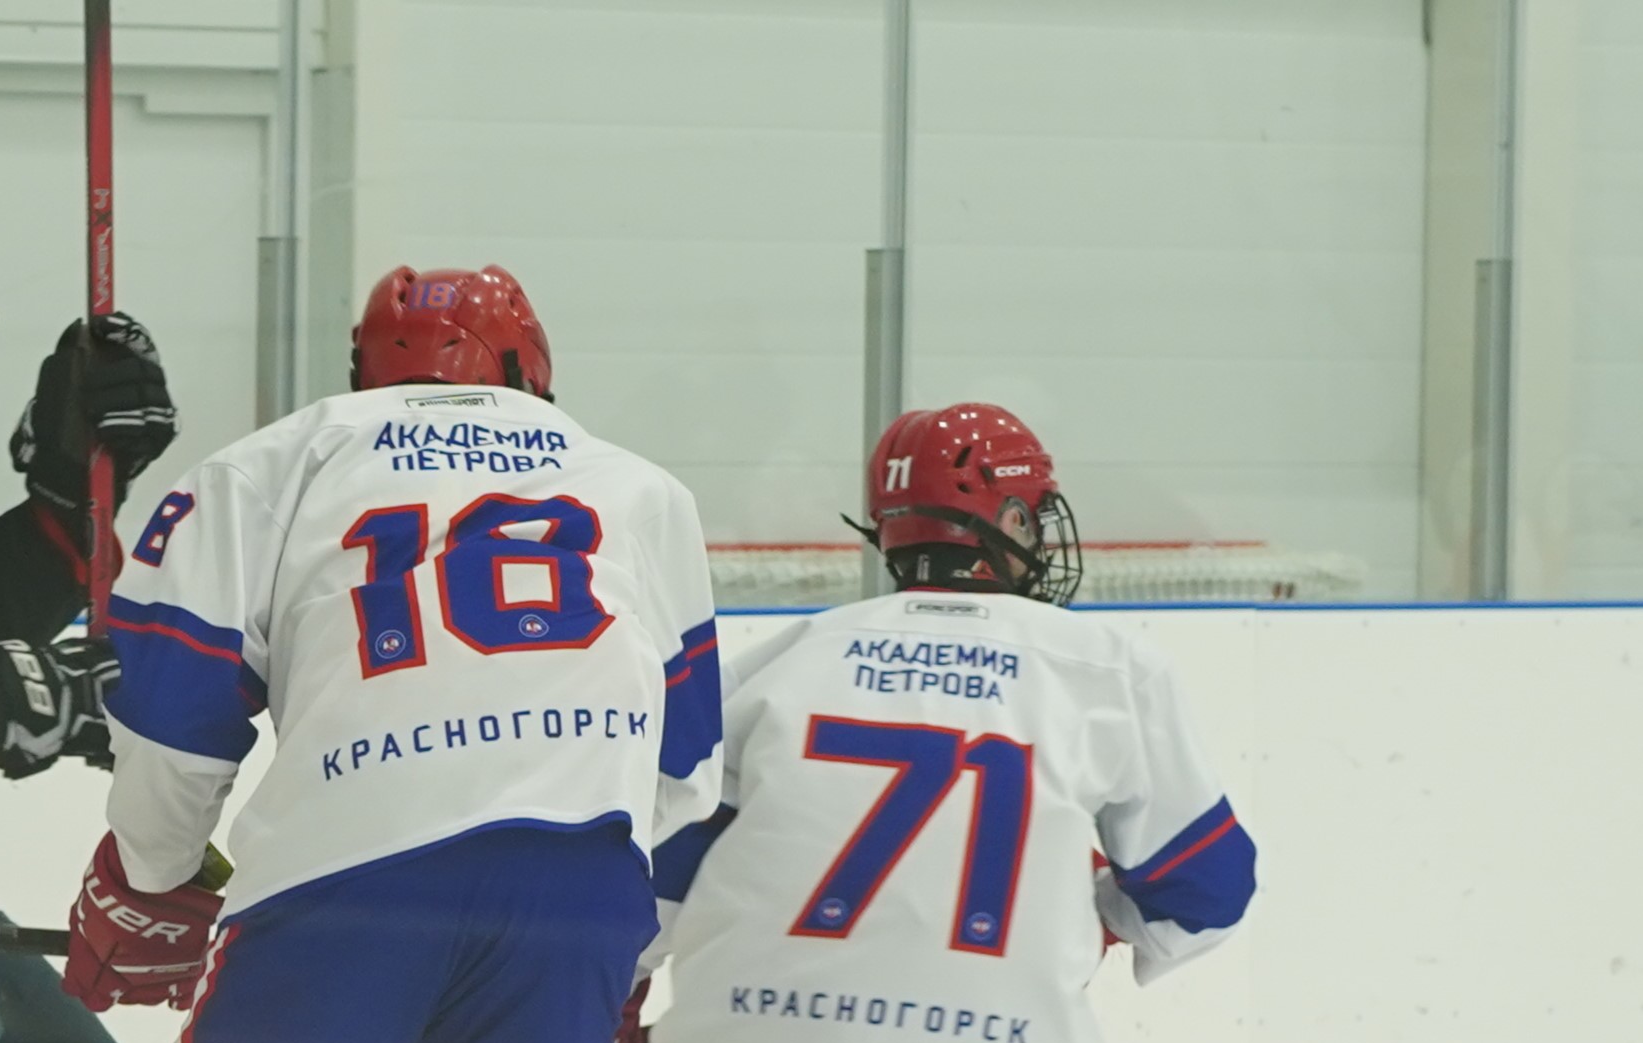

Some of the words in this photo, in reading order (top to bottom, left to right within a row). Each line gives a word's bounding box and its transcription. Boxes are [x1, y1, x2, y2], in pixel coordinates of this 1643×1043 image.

[411, 282, 454, 310] 18
[373, 422, 569, 453] АКАДЕМИЯ
[392, 448, 562, 473] ПЕТРОВА
[886, 455, 914, 492] 71
[994, 465, 1031, 477] CCM
[341, 491, 616, 680] 18
[844, 639, 1018, 680] АКАДЕМИЯ
[855, 664, 1003, 704] ПЕТРОВА
[321, 707, 649, 782] КРАСНОГОРСК
[787, 713, 1034, 957] 71
[85, 874, 191, 945] UER
